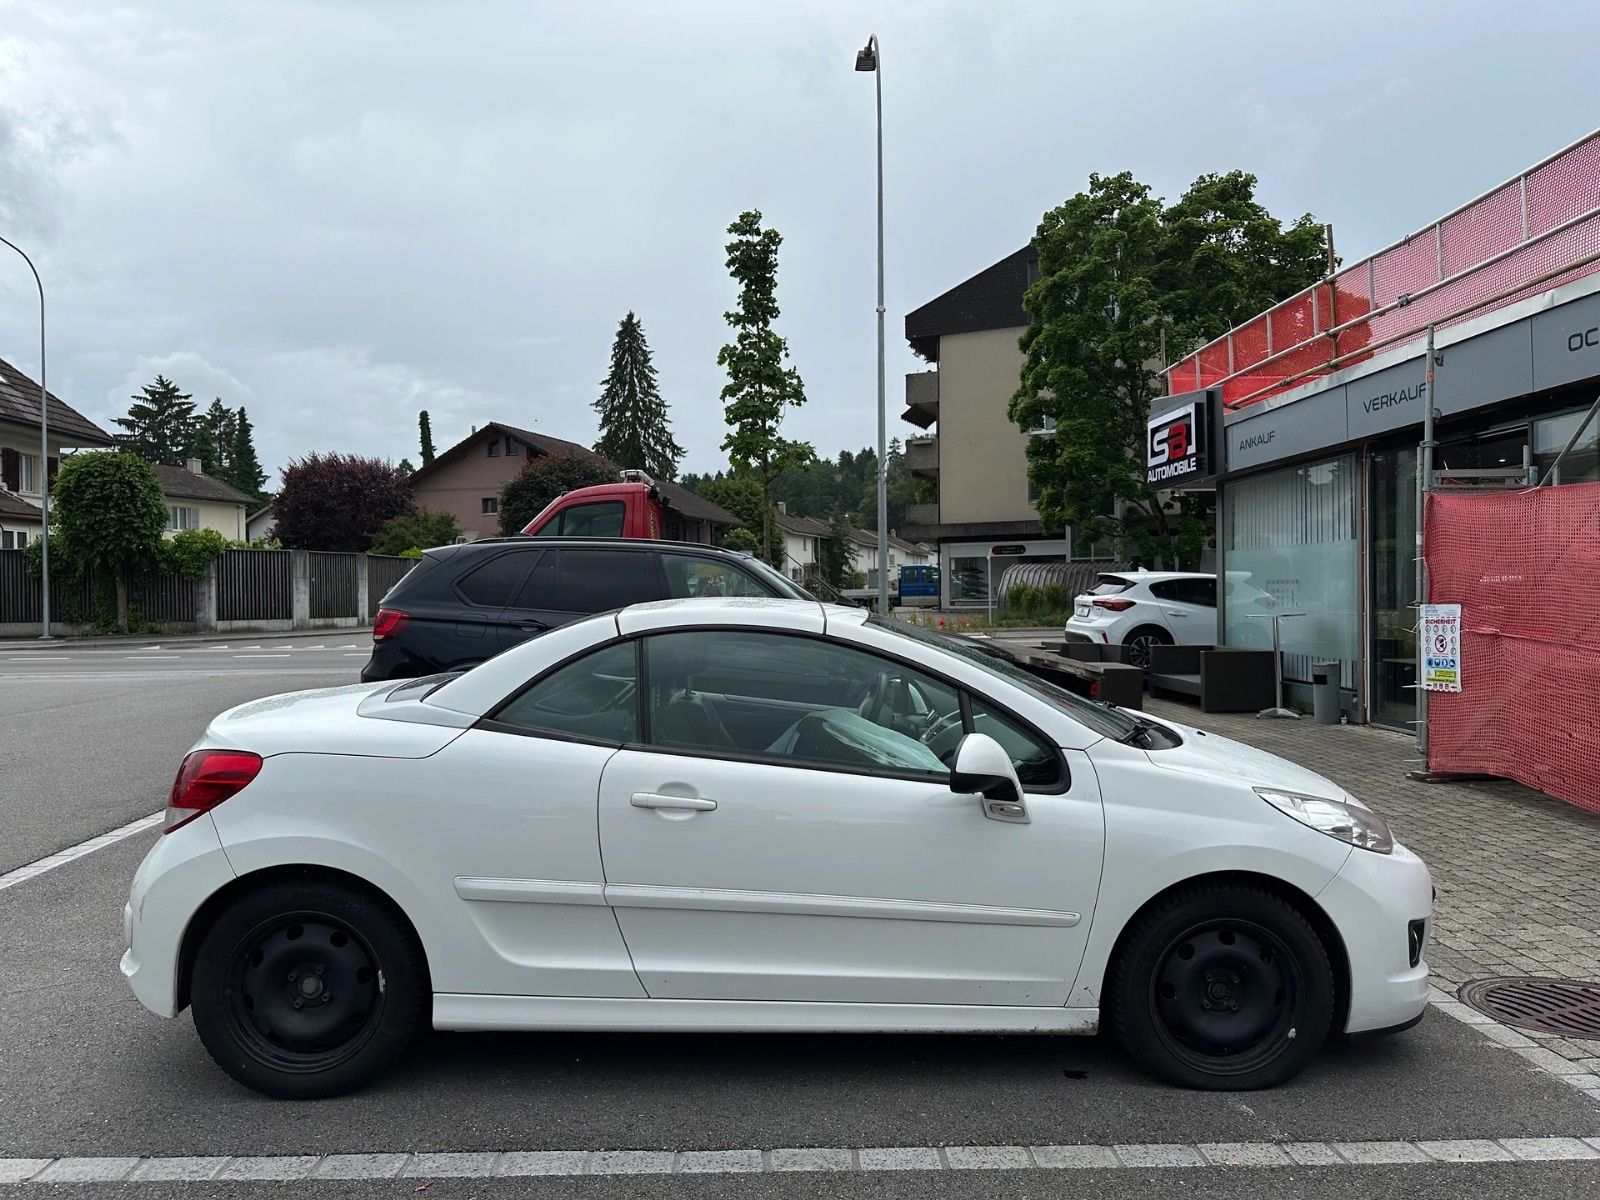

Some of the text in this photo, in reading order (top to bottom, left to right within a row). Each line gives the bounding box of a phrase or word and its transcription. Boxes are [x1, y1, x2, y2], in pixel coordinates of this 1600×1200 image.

[1568, 326, 1599, 352] OC
[1363, 382, 1427, 414] VERKAUF
[1152, 421, 1187, 464] SB
[1239, 430, 1276, 452] ANKAUF
[1147, 456, 1197, 483] AUTOMOBILE
